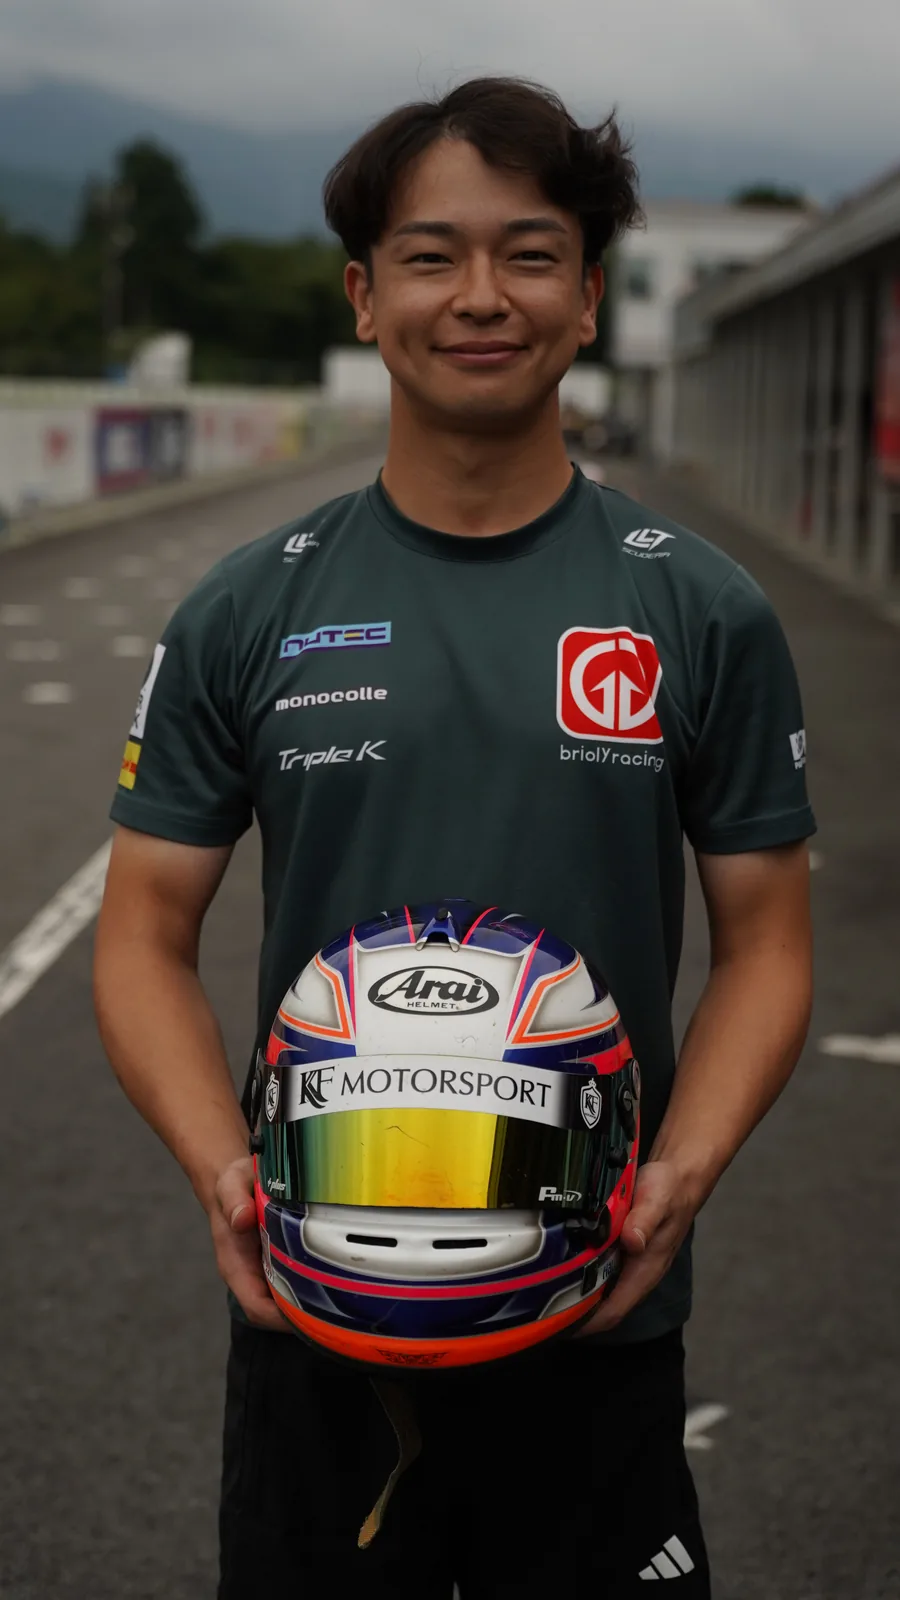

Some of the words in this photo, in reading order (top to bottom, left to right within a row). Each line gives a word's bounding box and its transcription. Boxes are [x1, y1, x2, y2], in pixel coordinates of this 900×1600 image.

[275, 687, 388, 711] monocolle
[278, 746, 354, 771] Triple
[355, 740, 387, 761] K
[374, 970, 484, 1003] Arai
[407, 1001, 456, 1009] HELMET
[298, 1066, 335, 1109] KF
[341, 1068, 552, 1108] MOTORSPORT
